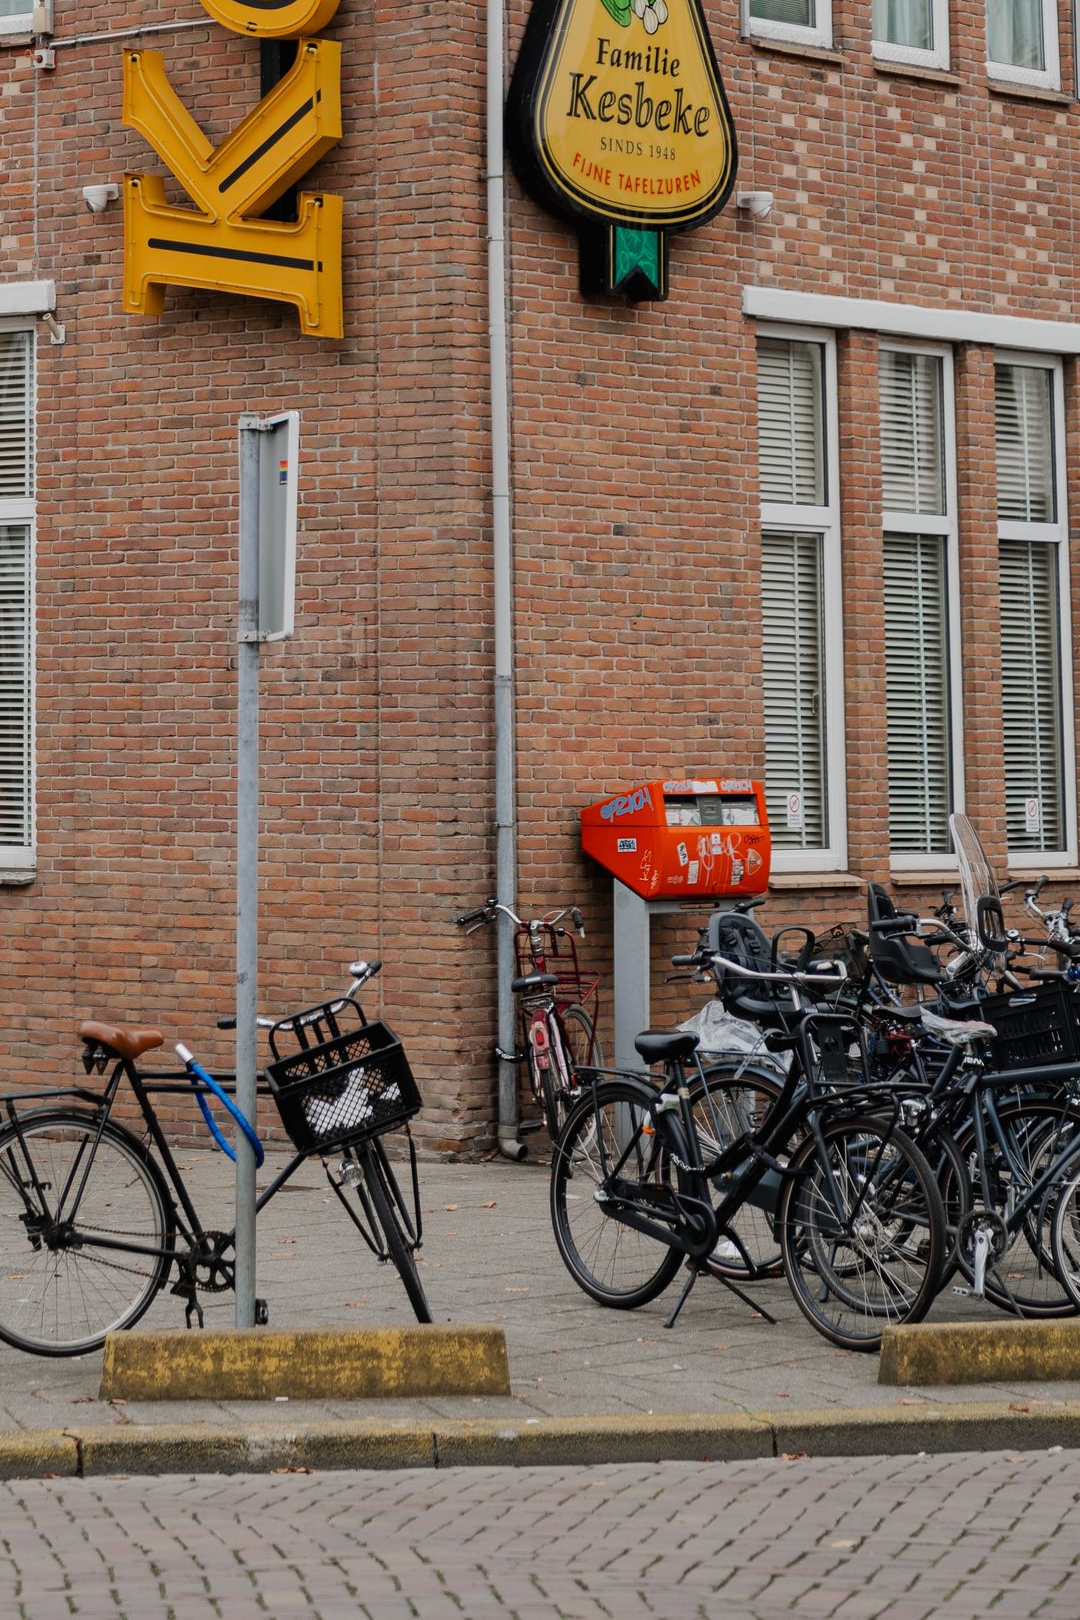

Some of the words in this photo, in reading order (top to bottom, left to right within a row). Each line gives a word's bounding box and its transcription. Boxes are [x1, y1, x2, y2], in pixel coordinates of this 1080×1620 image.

[596, 37, 680, 77] Familie
[566, 72, 710, 137] Kesbeke
[600, 136, 643, 156] SINDS
[649, 144, 676, 161] 1948
[572, 152, 611, 186] FIJNE
[618, 169, 701, 195] TAFELZUREN
